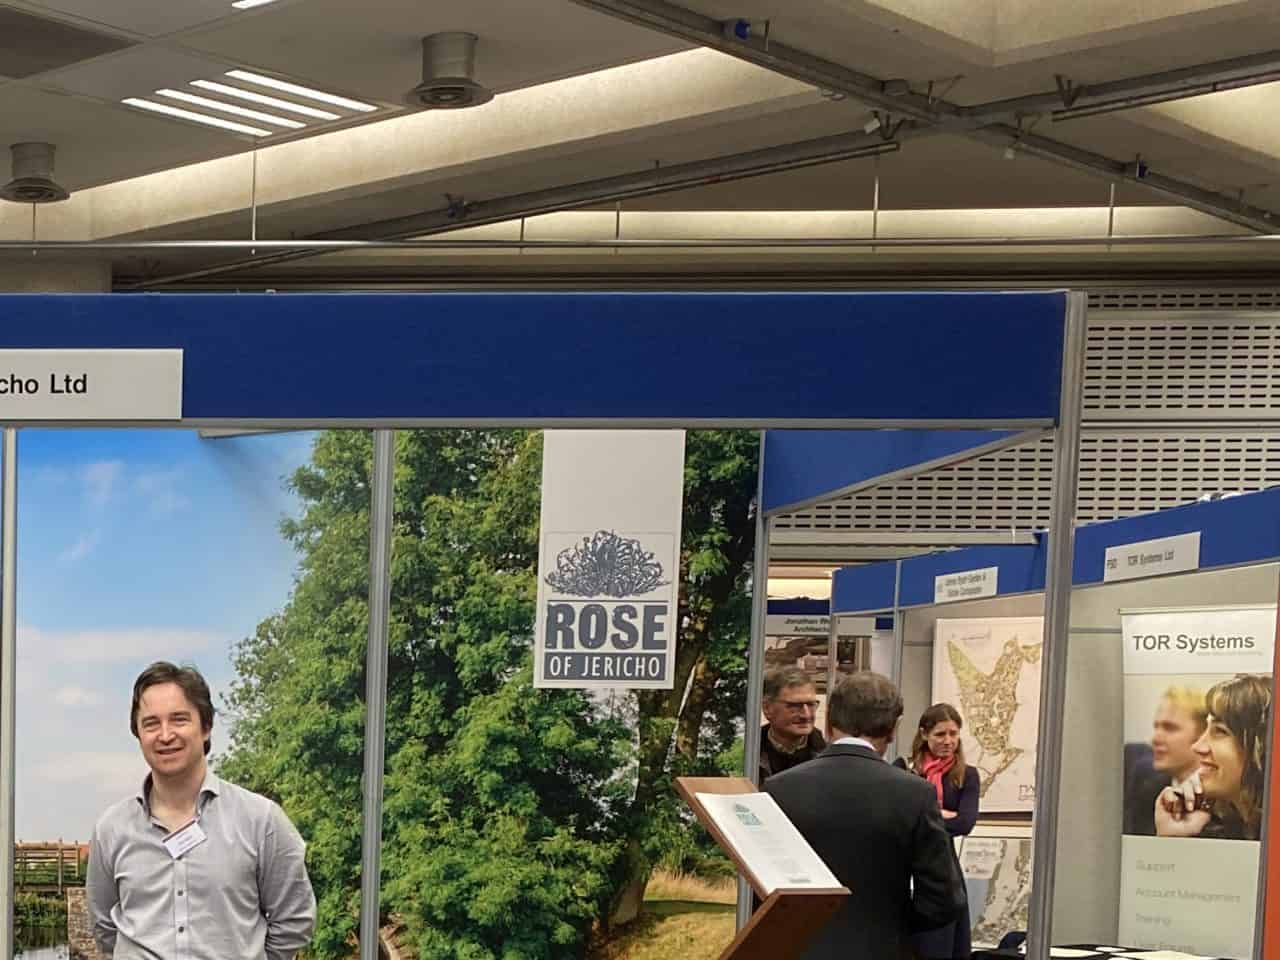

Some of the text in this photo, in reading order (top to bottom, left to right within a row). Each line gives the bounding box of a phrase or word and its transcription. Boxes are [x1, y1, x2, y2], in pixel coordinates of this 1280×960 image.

[50, 373, 88, 395] Ltd
[545, 603, 668, 650] ROSE
[1133, 633, 1255, 654] TOR Systems
[550, 655, 660, 678] OF JERICHO
